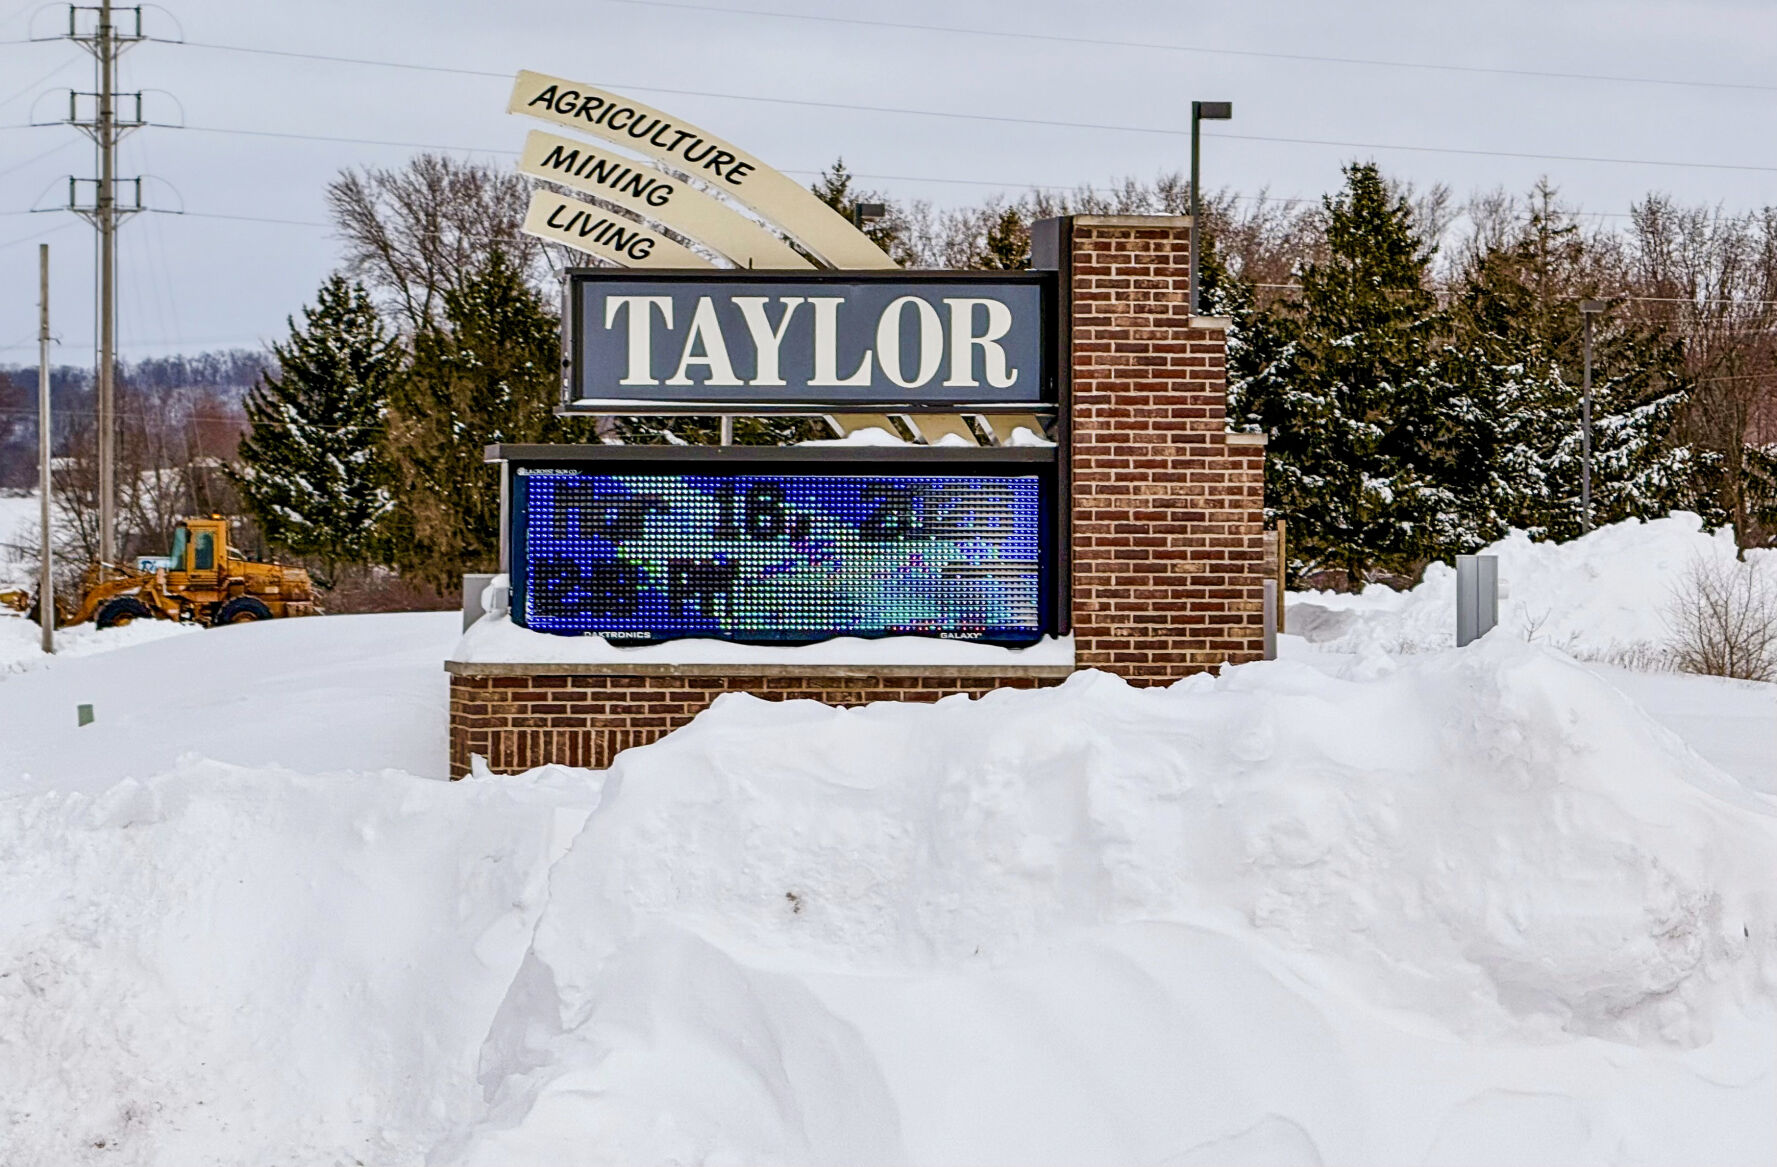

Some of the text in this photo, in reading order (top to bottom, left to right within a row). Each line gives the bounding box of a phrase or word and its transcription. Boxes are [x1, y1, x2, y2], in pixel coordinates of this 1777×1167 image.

[528, 84, 755, 185] AGRICULTURE
[541, 145, 674, 207] MINING
[547, 204, 656, 260] LIVING
[604, 295, 1018, 389] TAYLOR
